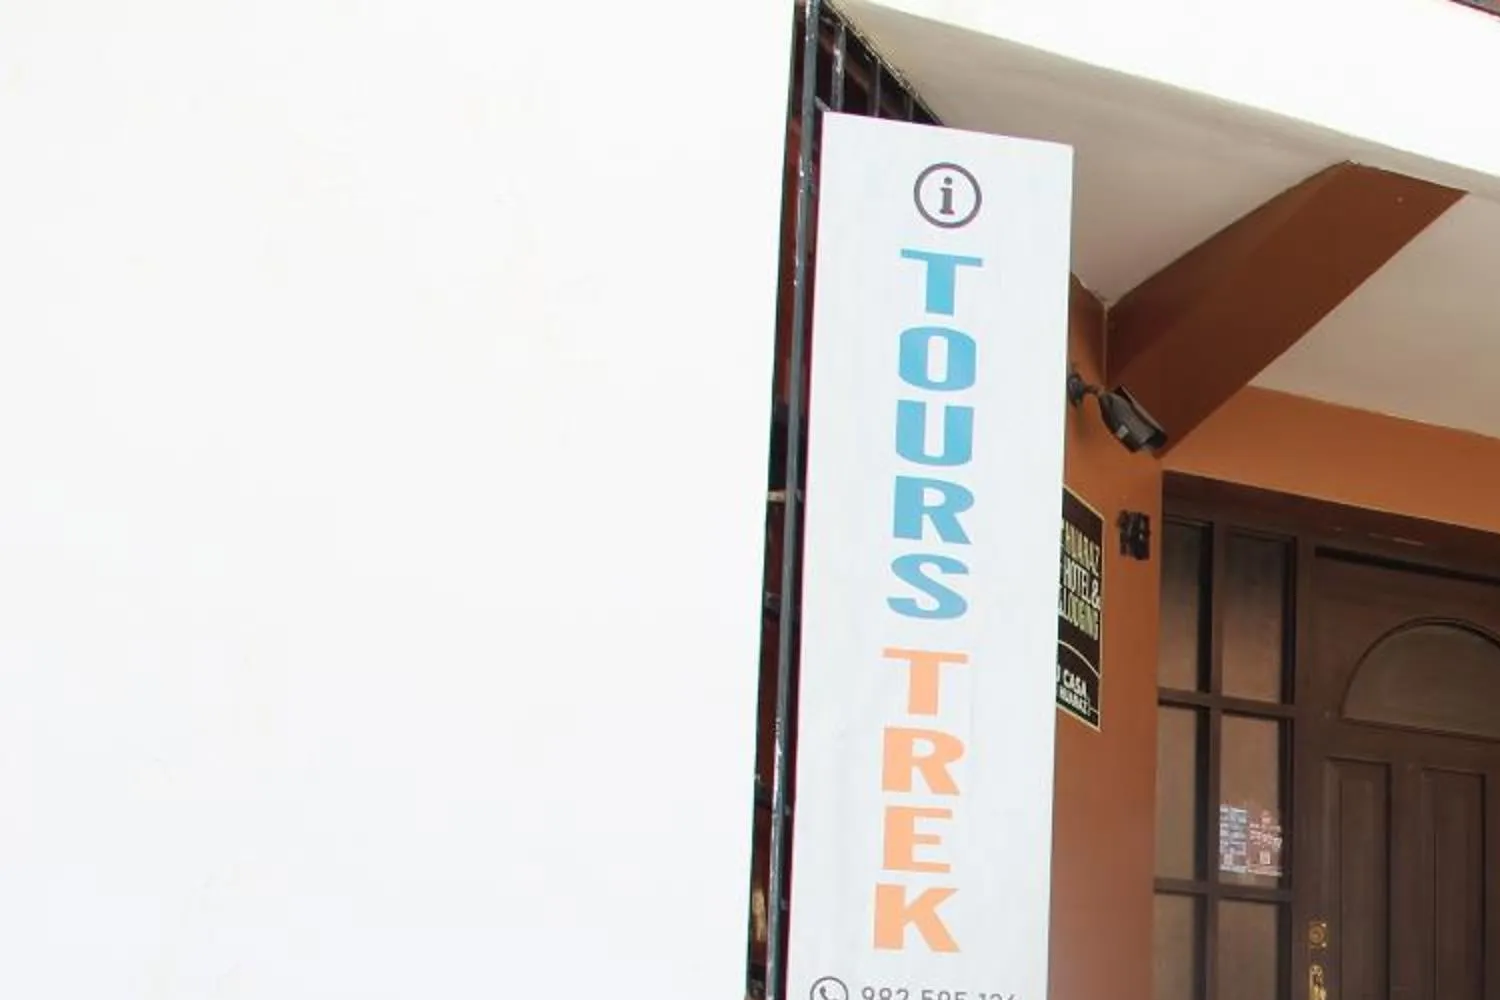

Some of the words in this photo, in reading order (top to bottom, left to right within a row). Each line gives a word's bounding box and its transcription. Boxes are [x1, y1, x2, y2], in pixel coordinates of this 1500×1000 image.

[887, 248, 984, 620] TOURS
[1063, 553, 1091, 604] HOTEL
[1063, 668, 1087, 700] CASA
[873, 647, 969, 953] TREK
